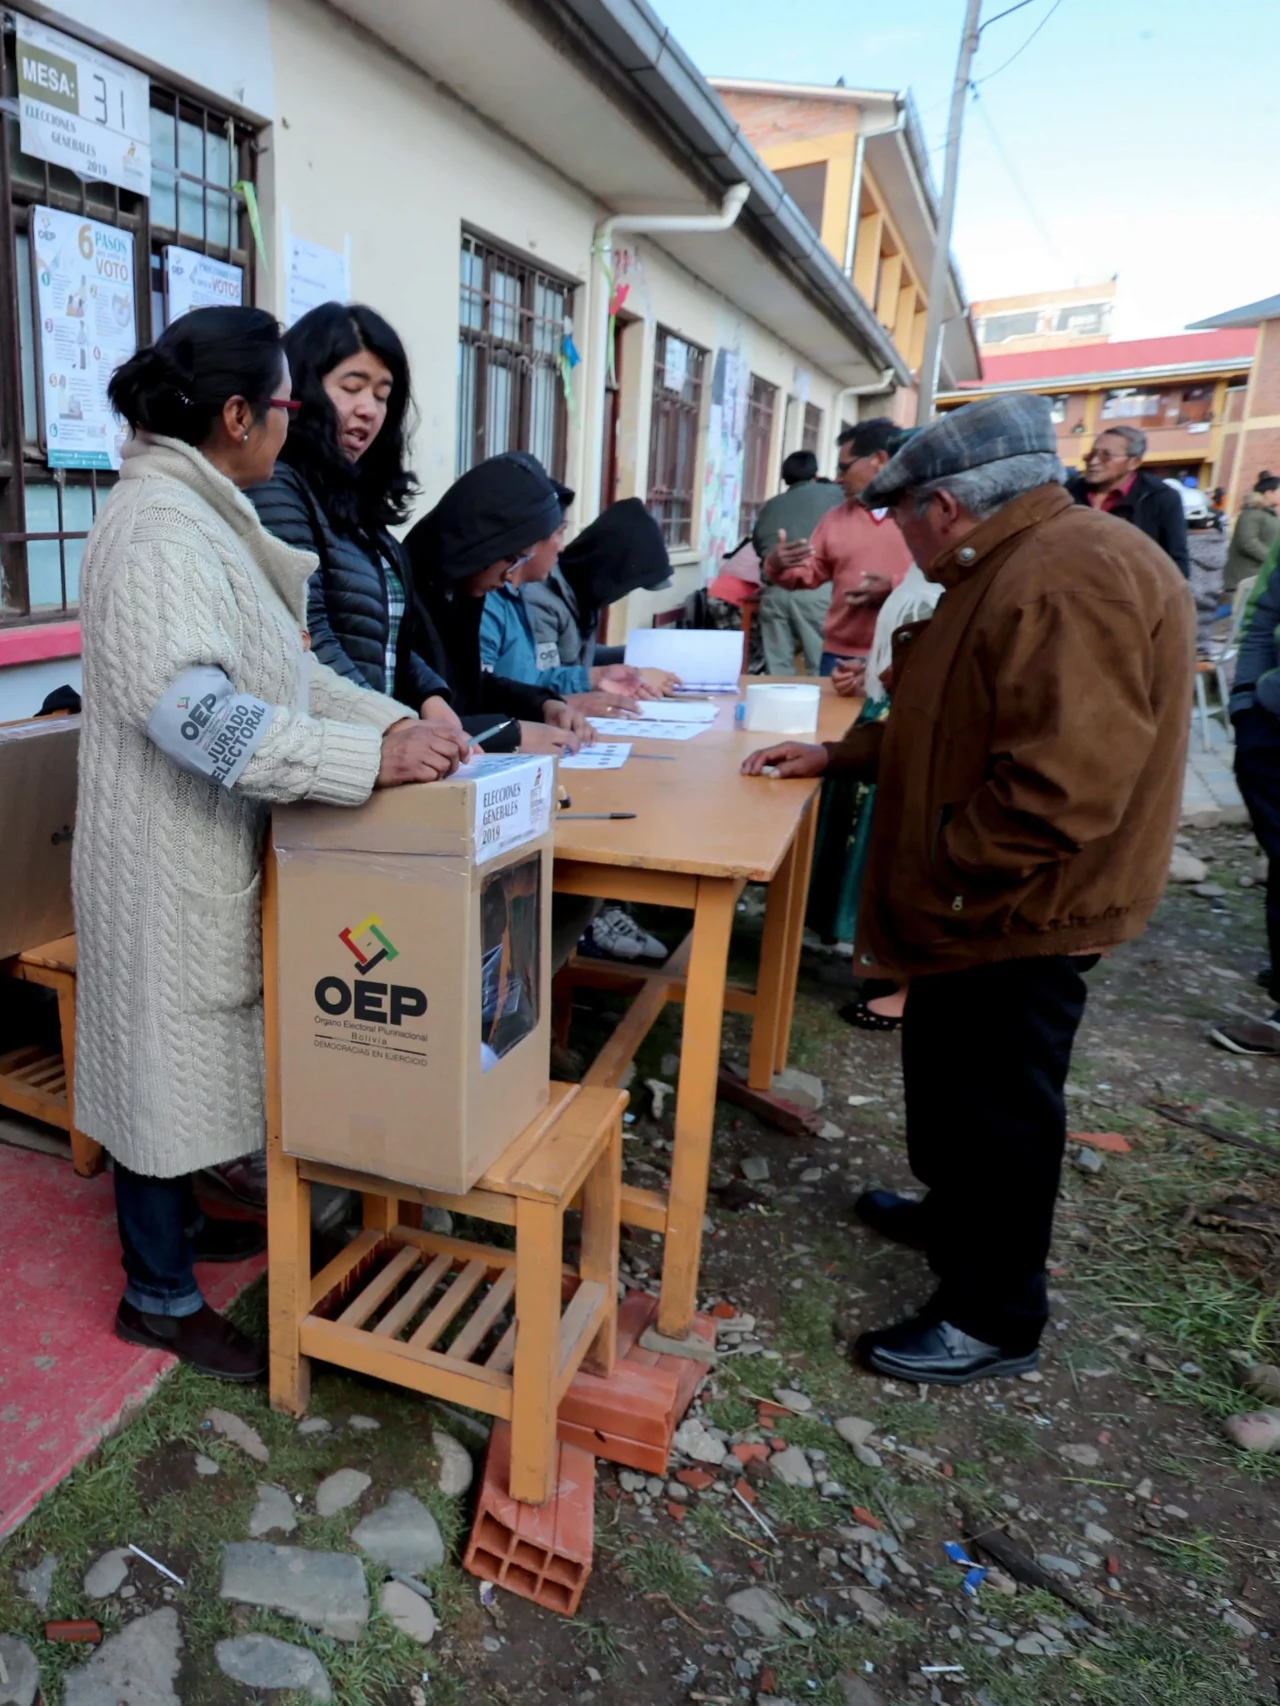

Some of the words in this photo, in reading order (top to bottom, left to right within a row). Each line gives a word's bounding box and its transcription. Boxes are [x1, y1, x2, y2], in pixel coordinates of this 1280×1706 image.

[22, 56, 76, 98] MESA:
[93, 73, 125, 130] 31
[25, 104, 77, 134] ELECCIONES
[51, 131, 97, 157] GENERALES
[86, 160, 108, 177] 2019
[38, 229, 56, 241] OEP
[78, 223, 94, 261] 6
[95, 231, 128, 253] PASOS
[96, 257, 129, 282] VOTO
[212, 276, 240, 298] VOTOS
[181, 693, 216, 741] OEP
[208, 704, 249, 764] JURADO
[211, 705, 266, 781] ELECTORAL
[483, 782, 521, 808] ELECCIONES
[482, 800, 518, 826] GENERALES
[482, 825, 501, 845] 2019
[314, 976, 428, 1026] OEP
[314, 1015, 342, 1027] Órgano
[343, 1020, 376, 1033] Electoral
[378, 1026, 428, 1042] Plurinacional
[351, 1032, 388, 1045] Bolivia
[314, 1040, 370, 1056] DEMOCRACIAS
[372, 1050, 383, 1059] EN
[385, 1051, 428, 1067] EJERCICIO
